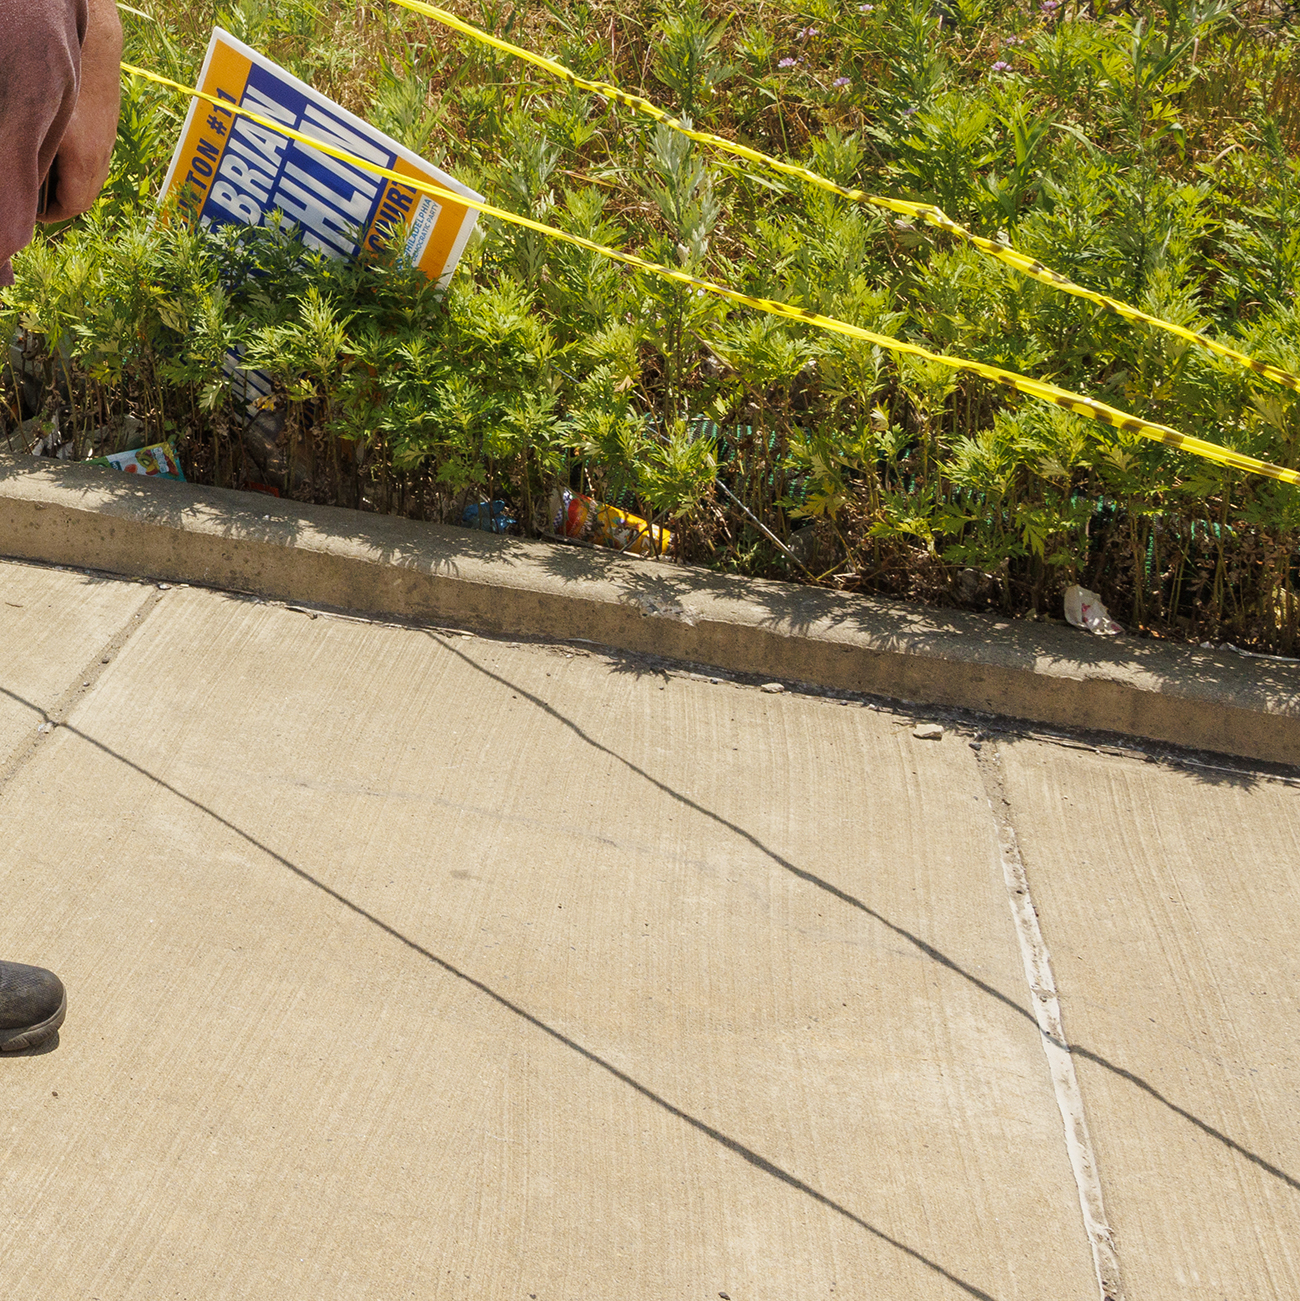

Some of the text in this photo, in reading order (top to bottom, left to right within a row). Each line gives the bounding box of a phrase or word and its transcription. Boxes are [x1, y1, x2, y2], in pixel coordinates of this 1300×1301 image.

[206, 87, 237, 137] #11
[210, 84, 297, 227] BRIAN
[426, 203, 438, 227] PARTY
